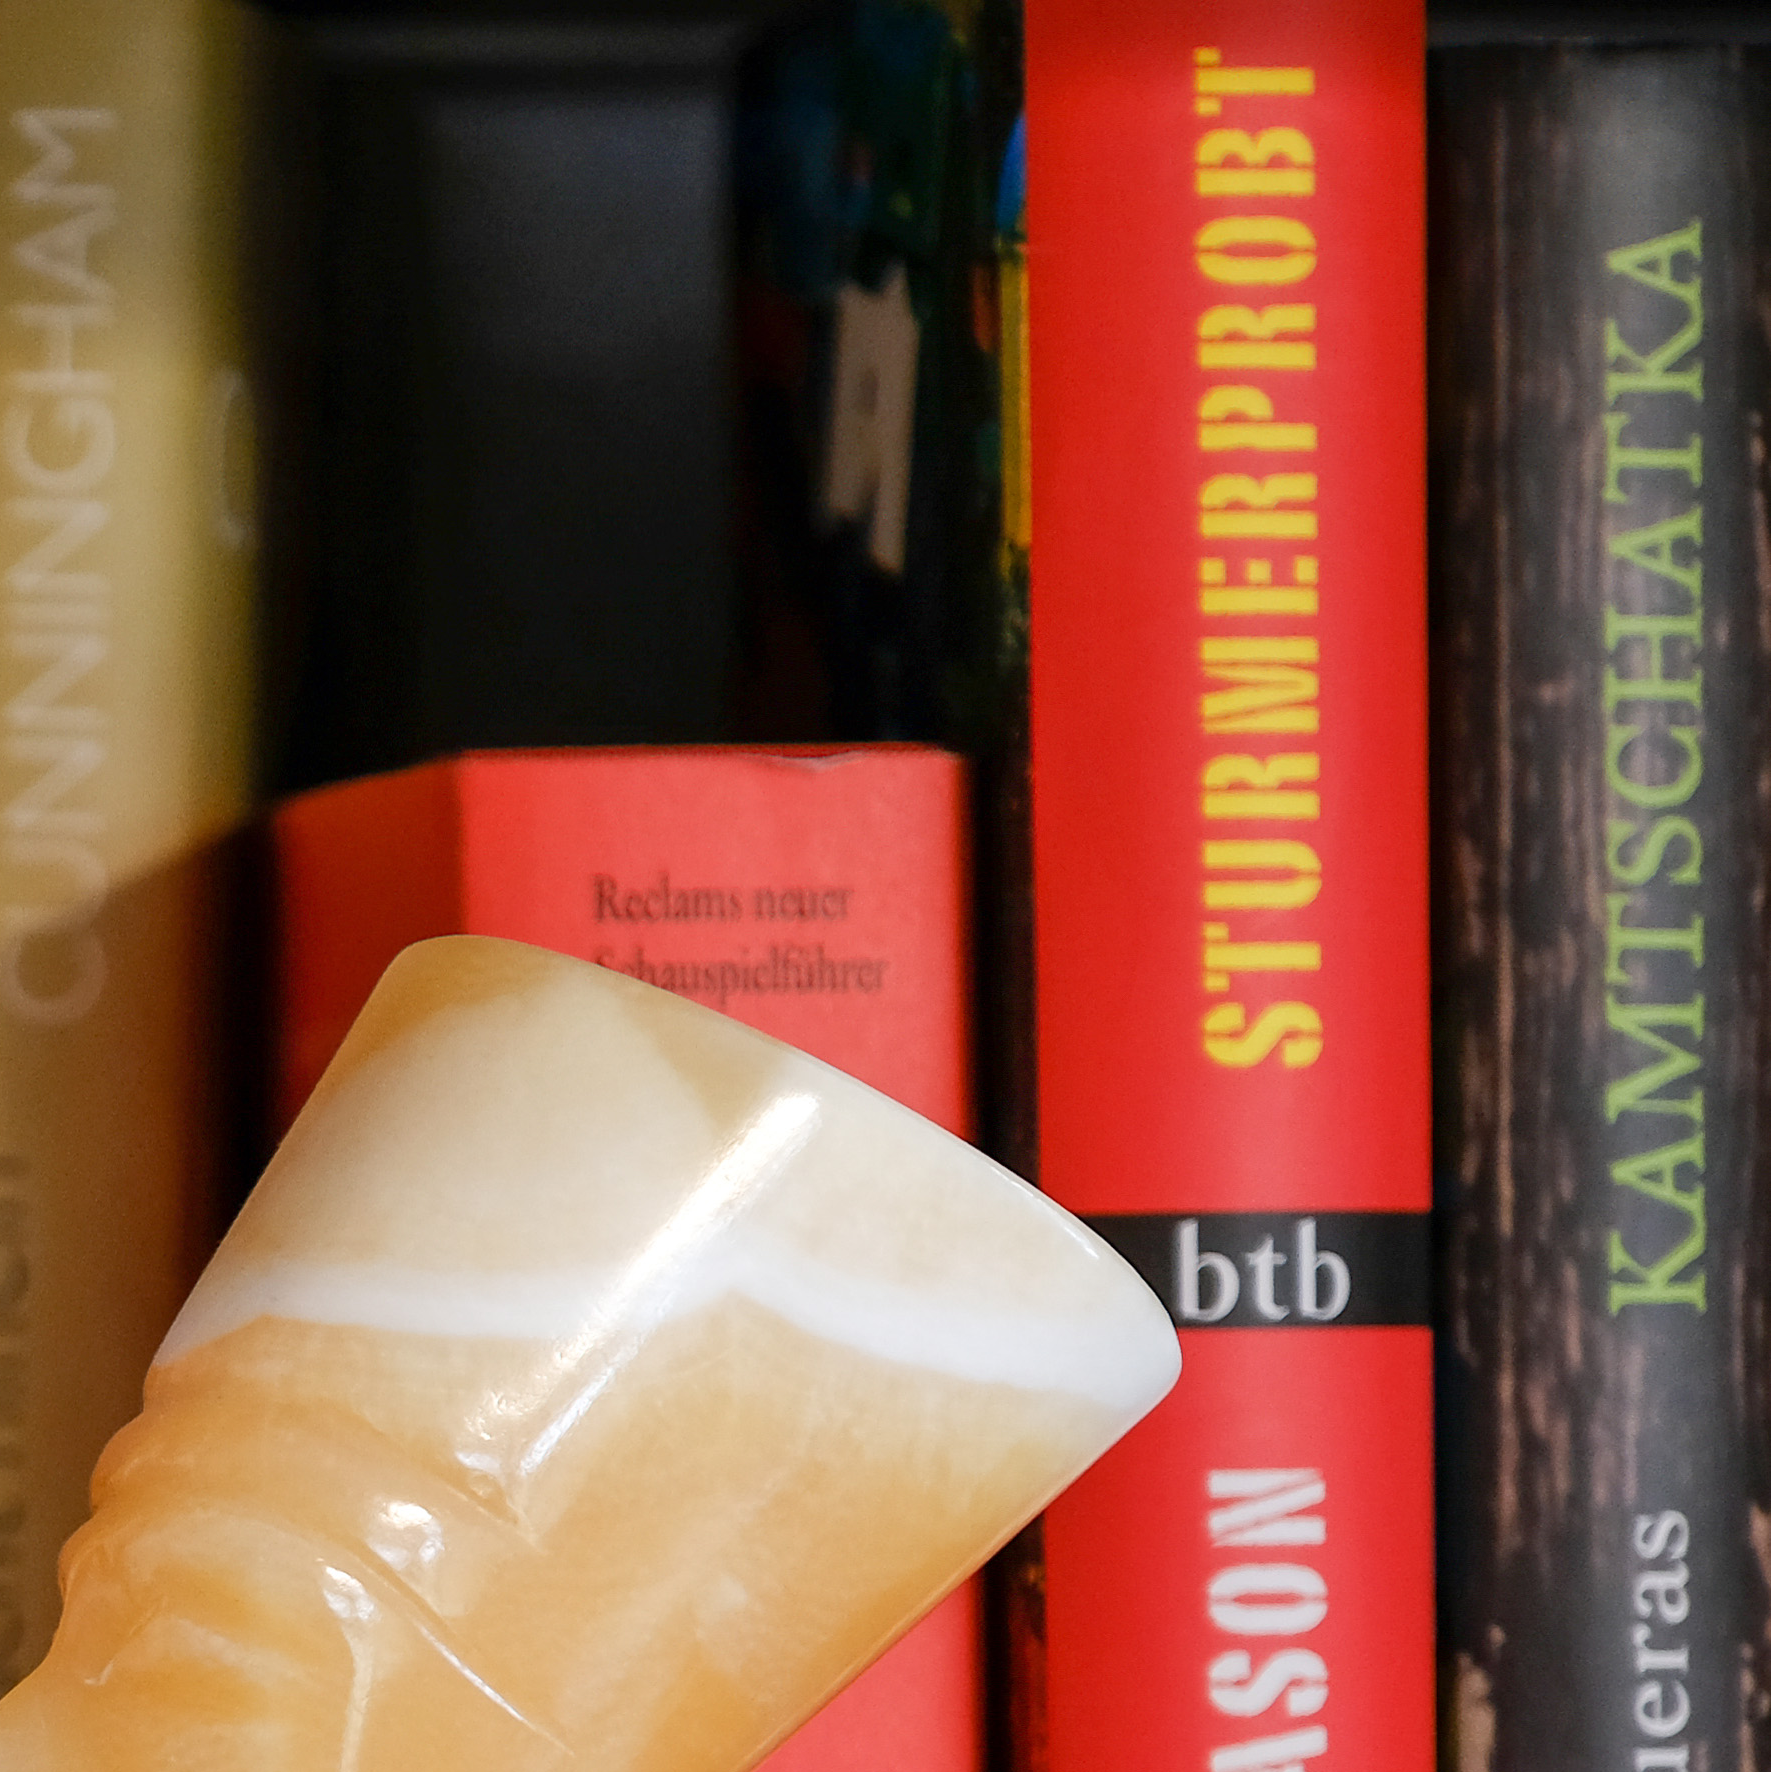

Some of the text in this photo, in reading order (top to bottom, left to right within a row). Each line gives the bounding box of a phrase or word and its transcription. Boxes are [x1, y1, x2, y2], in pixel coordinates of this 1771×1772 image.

[0, 106, 119, 1026] CUNNINGHAM
[592, 869, 855, 924] Reclams neuer
[1194, 44, 1325, 1071] STURMERPROBT
[1603, 221, 1707, 1317] KAMTSCHATKA
[1174, 1215, 1352, 1322] btb
